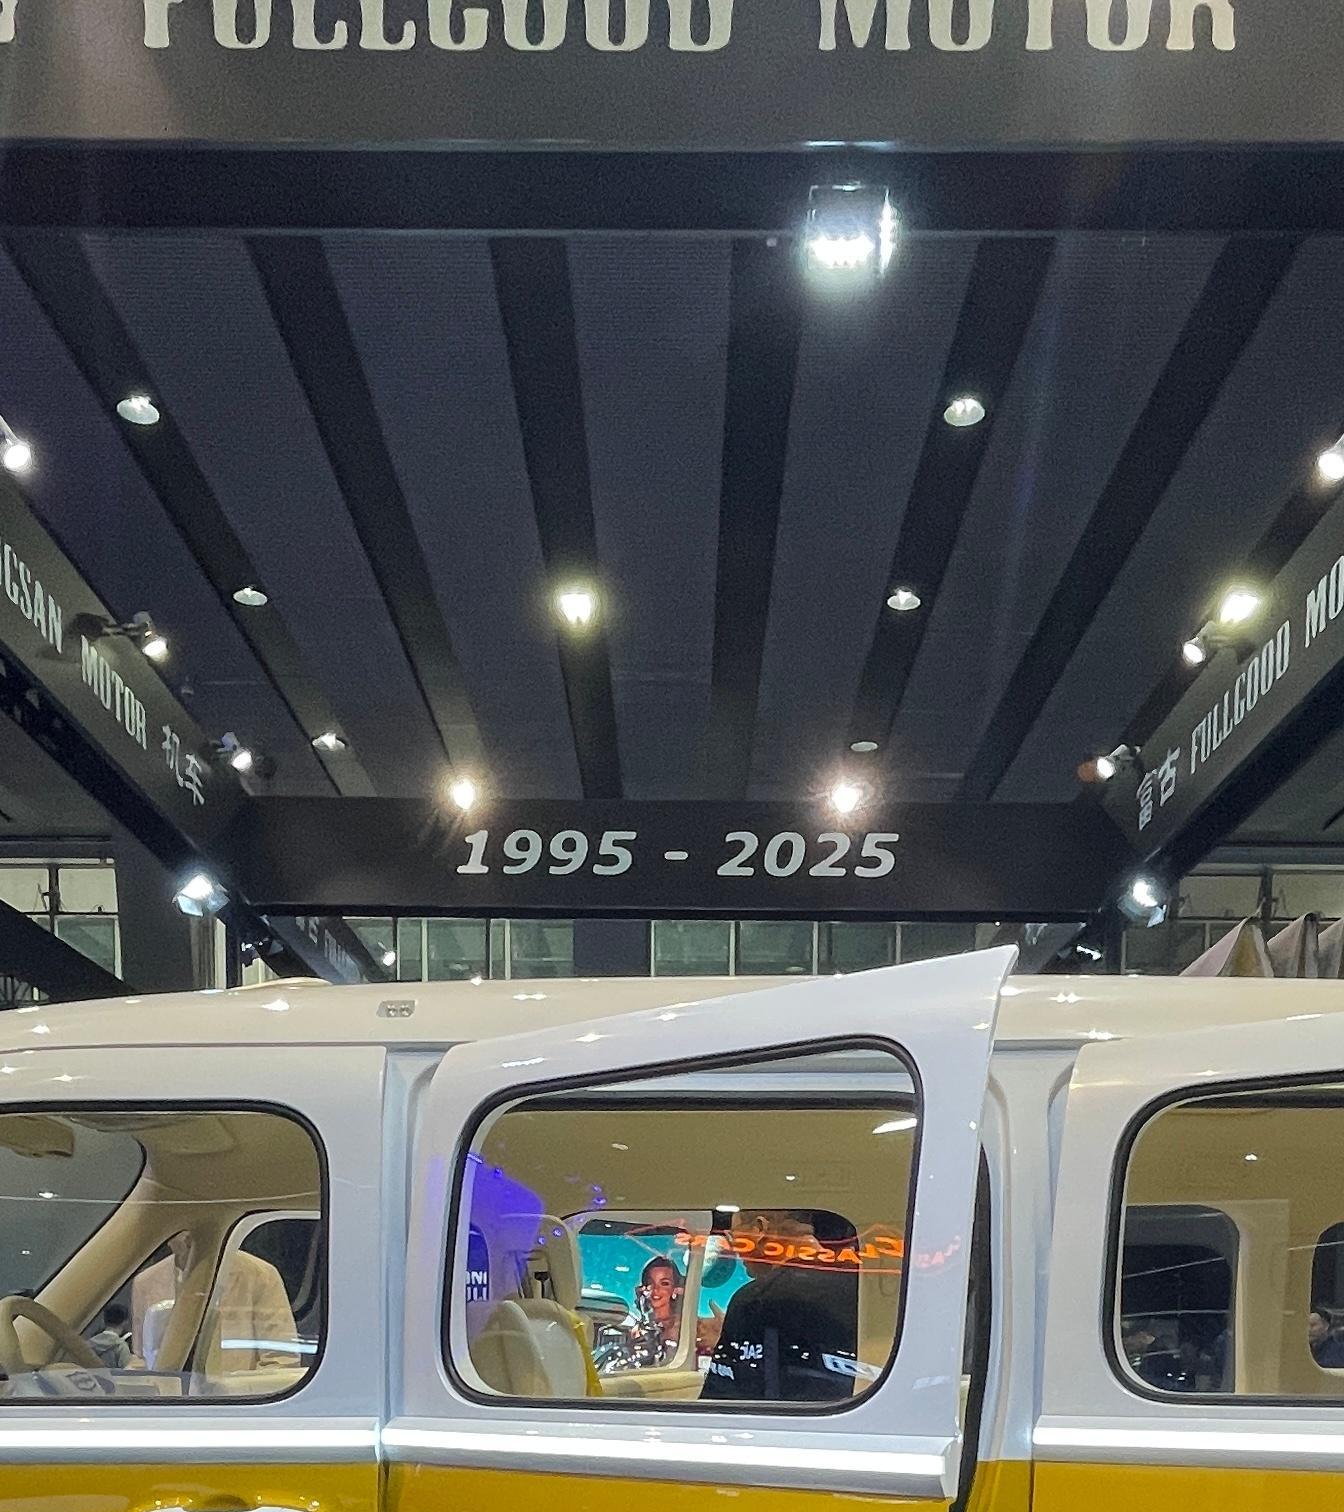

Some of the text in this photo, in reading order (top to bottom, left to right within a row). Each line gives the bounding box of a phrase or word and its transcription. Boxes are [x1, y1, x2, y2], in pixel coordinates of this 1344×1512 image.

[80, 634, 147, 750] MOTOR
[162, 725, 205, 805] 机车
[1136, 746, 1181, 831] 富古
[1190, 620, 1291, 774] FULLGOOD
[456, 829, 638, 875] 1995
[716, 831, 900, 878] 2025
